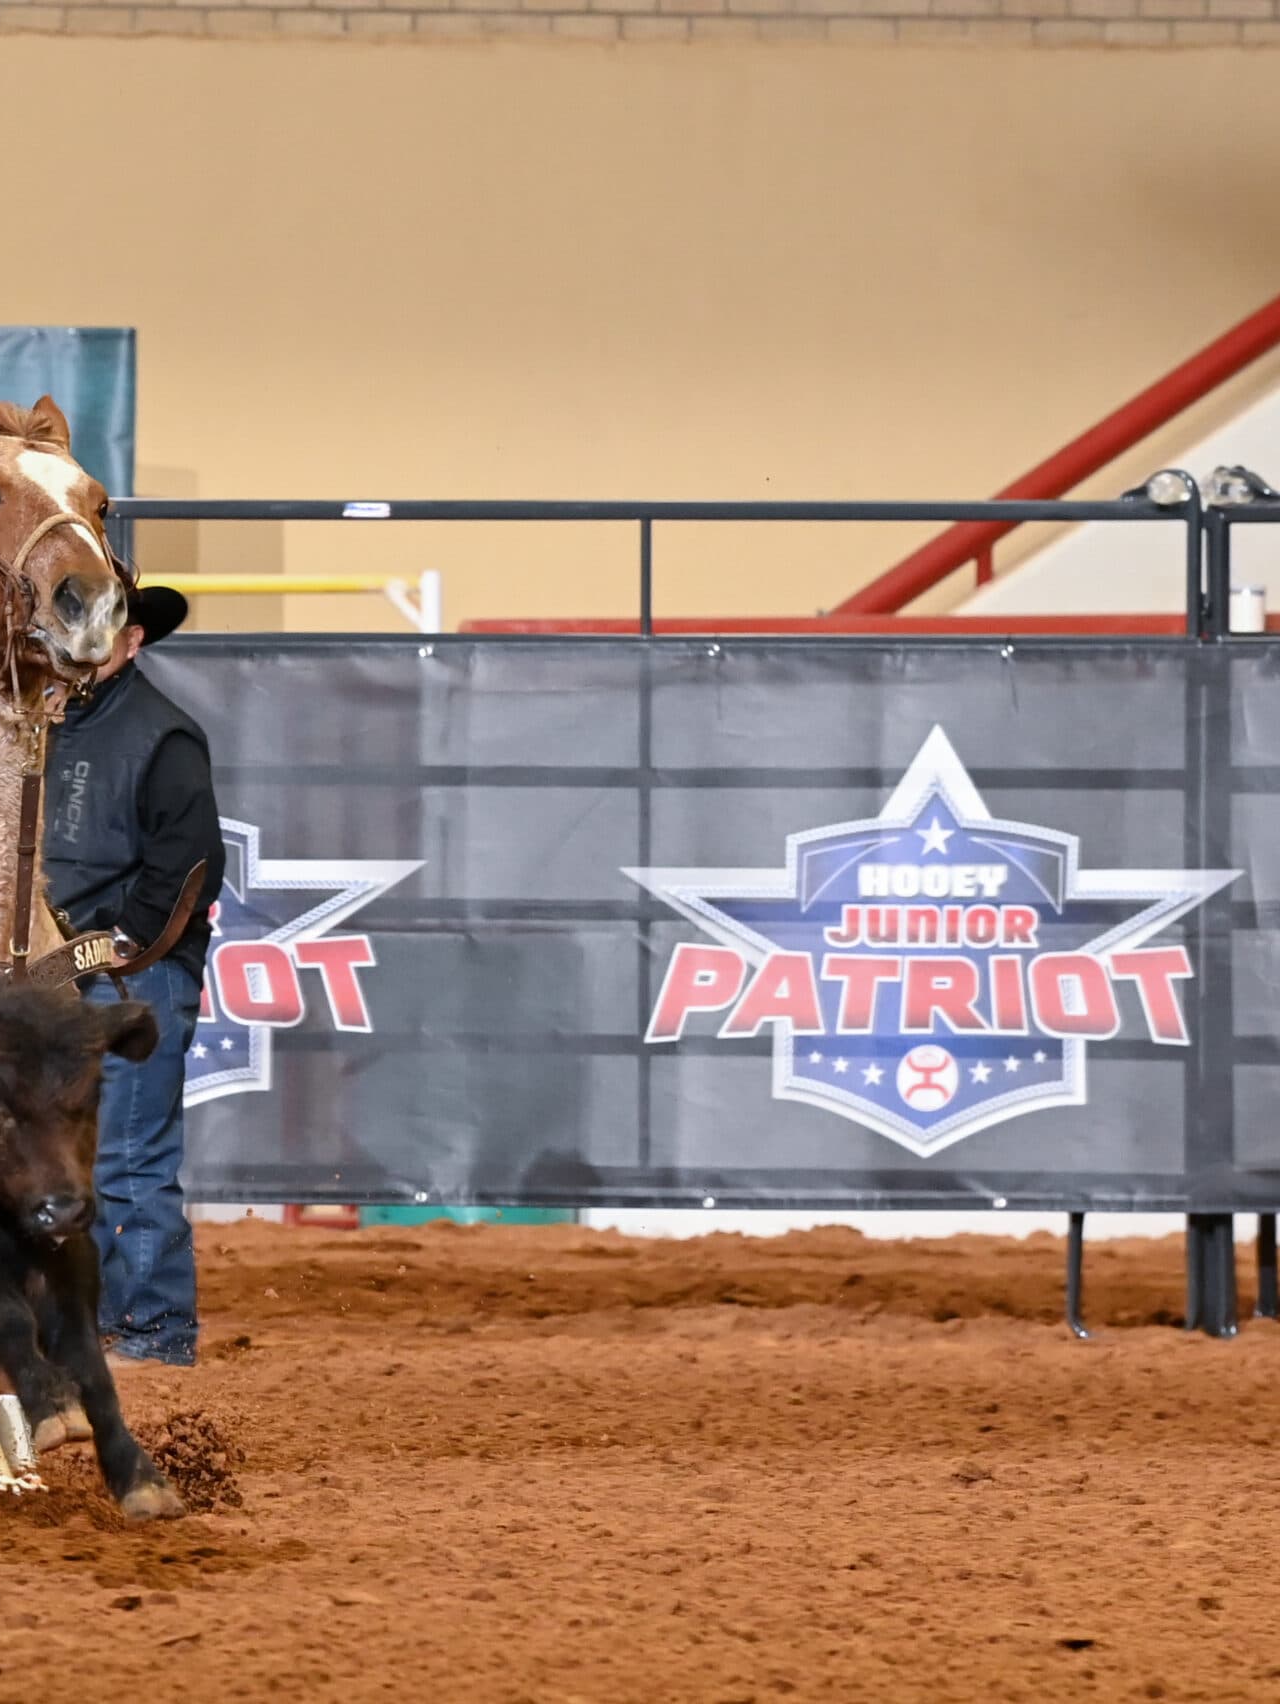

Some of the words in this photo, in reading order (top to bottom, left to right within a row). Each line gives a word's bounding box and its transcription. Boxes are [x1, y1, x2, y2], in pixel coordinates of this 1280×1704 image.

[63, 761, 90, 844] CINCH
[857, 863, 1008, 899] HOOEY
[823, 904, 1039, 948] JUNIOR
[644, 942, 1194, 1046] PATRIOT
